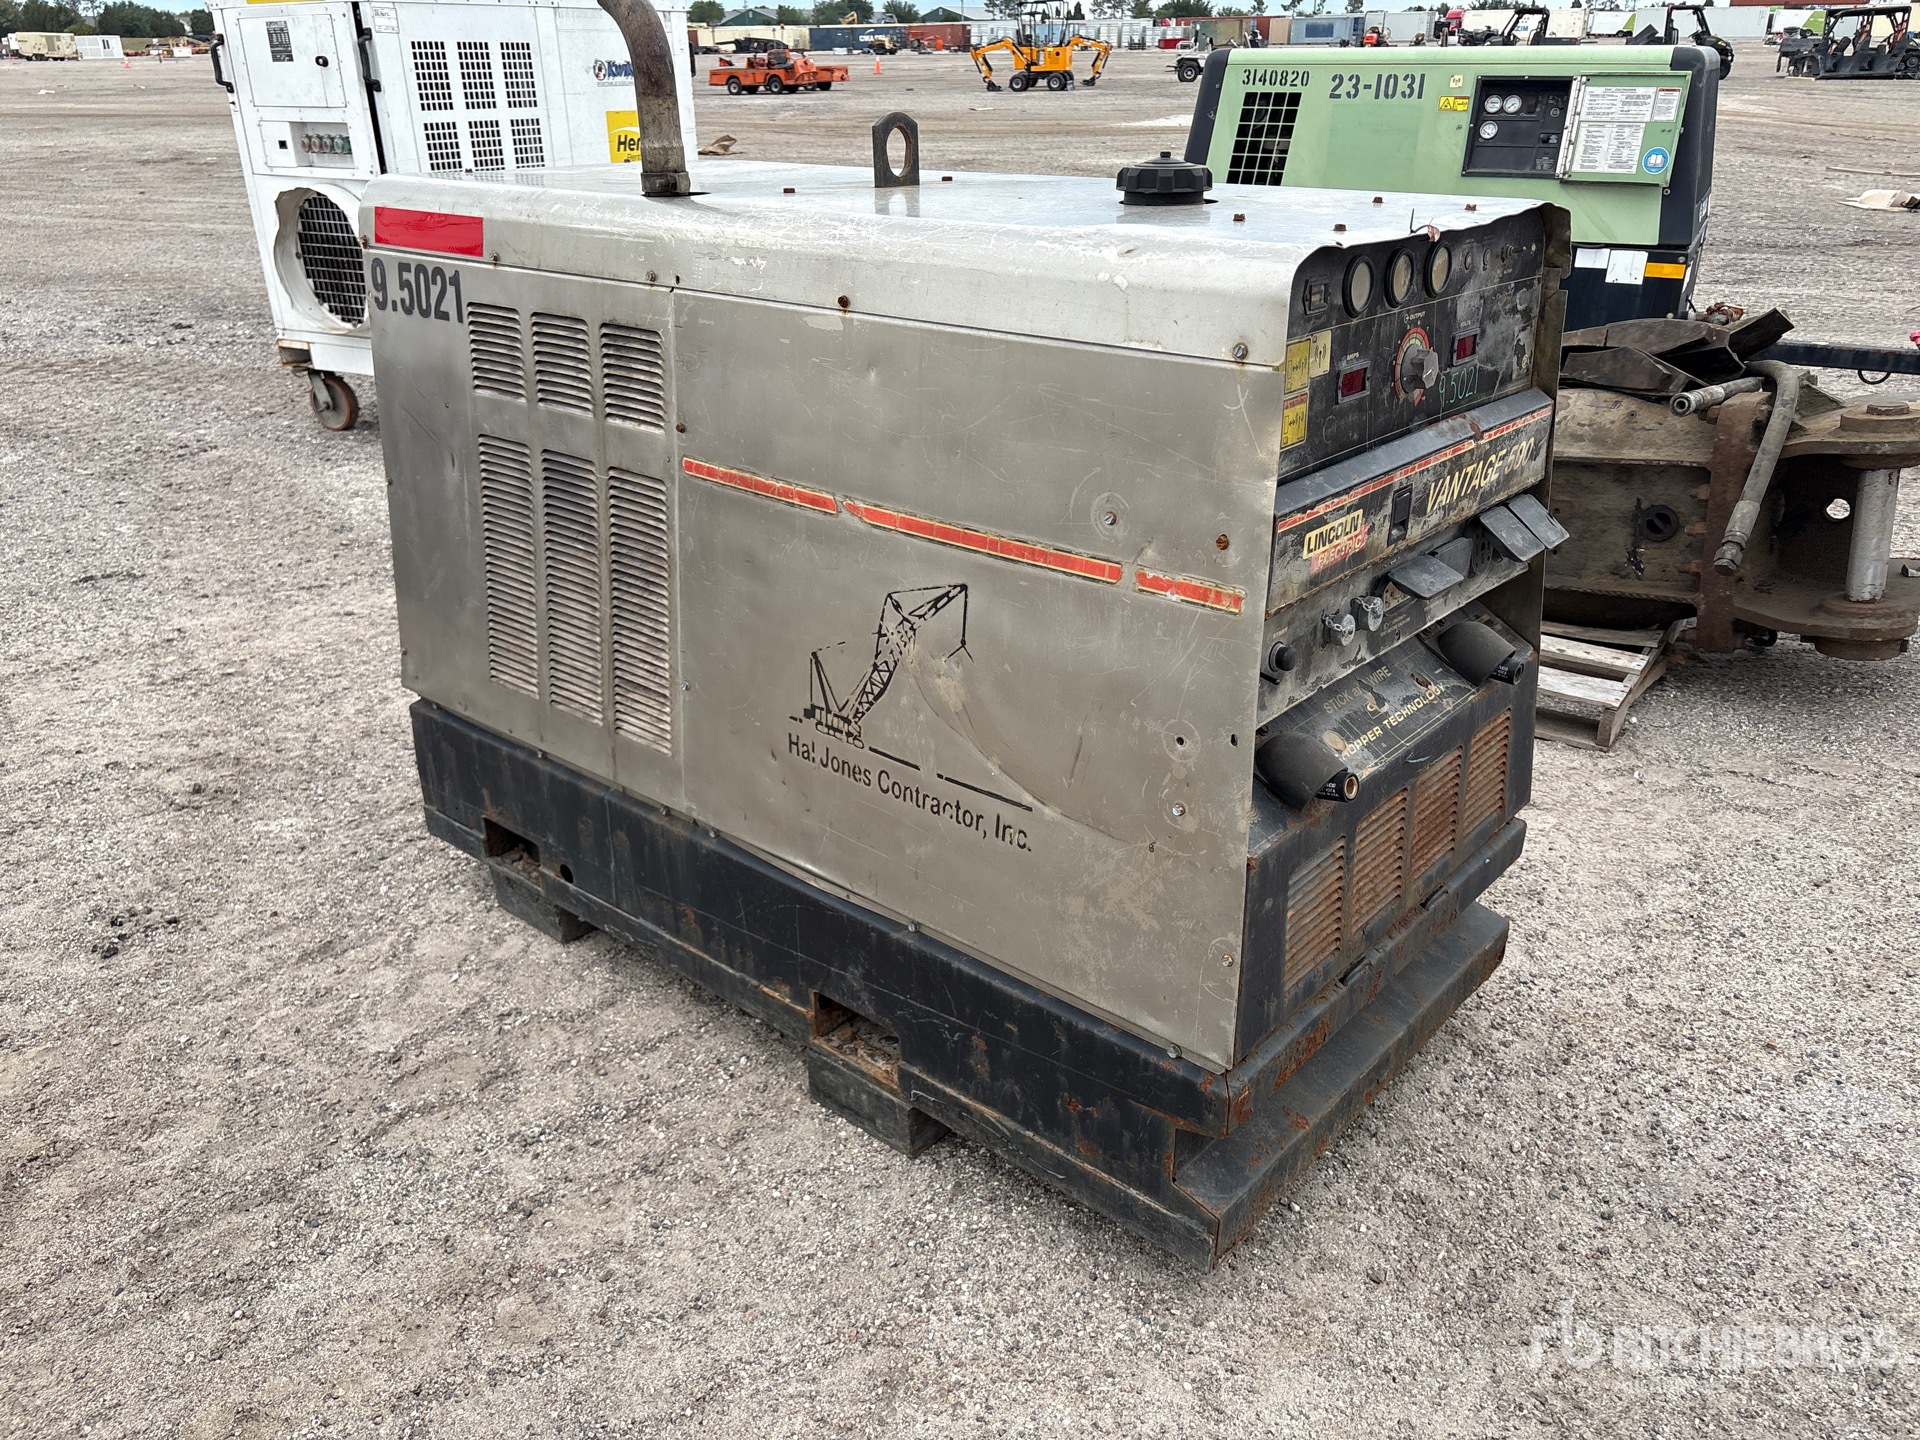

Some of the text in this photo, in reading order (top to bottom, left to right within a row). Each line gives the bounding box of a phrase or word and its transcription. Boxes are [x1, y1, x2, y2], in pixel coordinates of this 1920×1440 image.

[1242, 68, 1310, 87] 3140820
[1329, 73, 1426, 100] 23-1031
[616, 134, 641, 153] Her
[371, 257, 464, 324] 9.5021
[1410, 311, 1426, 320] OUTPUT
[1346, 352, 1360, 361] AMPS
[1438, 363, 1480, 408] 9.5021
[1426, 437, 1535, 514] VANTAGE 500
[1306, 514, 1360, 554] LINCOLN
[1323, 687, 1353, 714] STICK
[1367, 665, 1392, 686] WIRE
[1382, 683, 1446, 730] TECHNOLOGY
[819, 747, 872, 787] Jones
[877, 770, 988, 840] Contractor,
[994, 813, 1032, 853] Inc.
